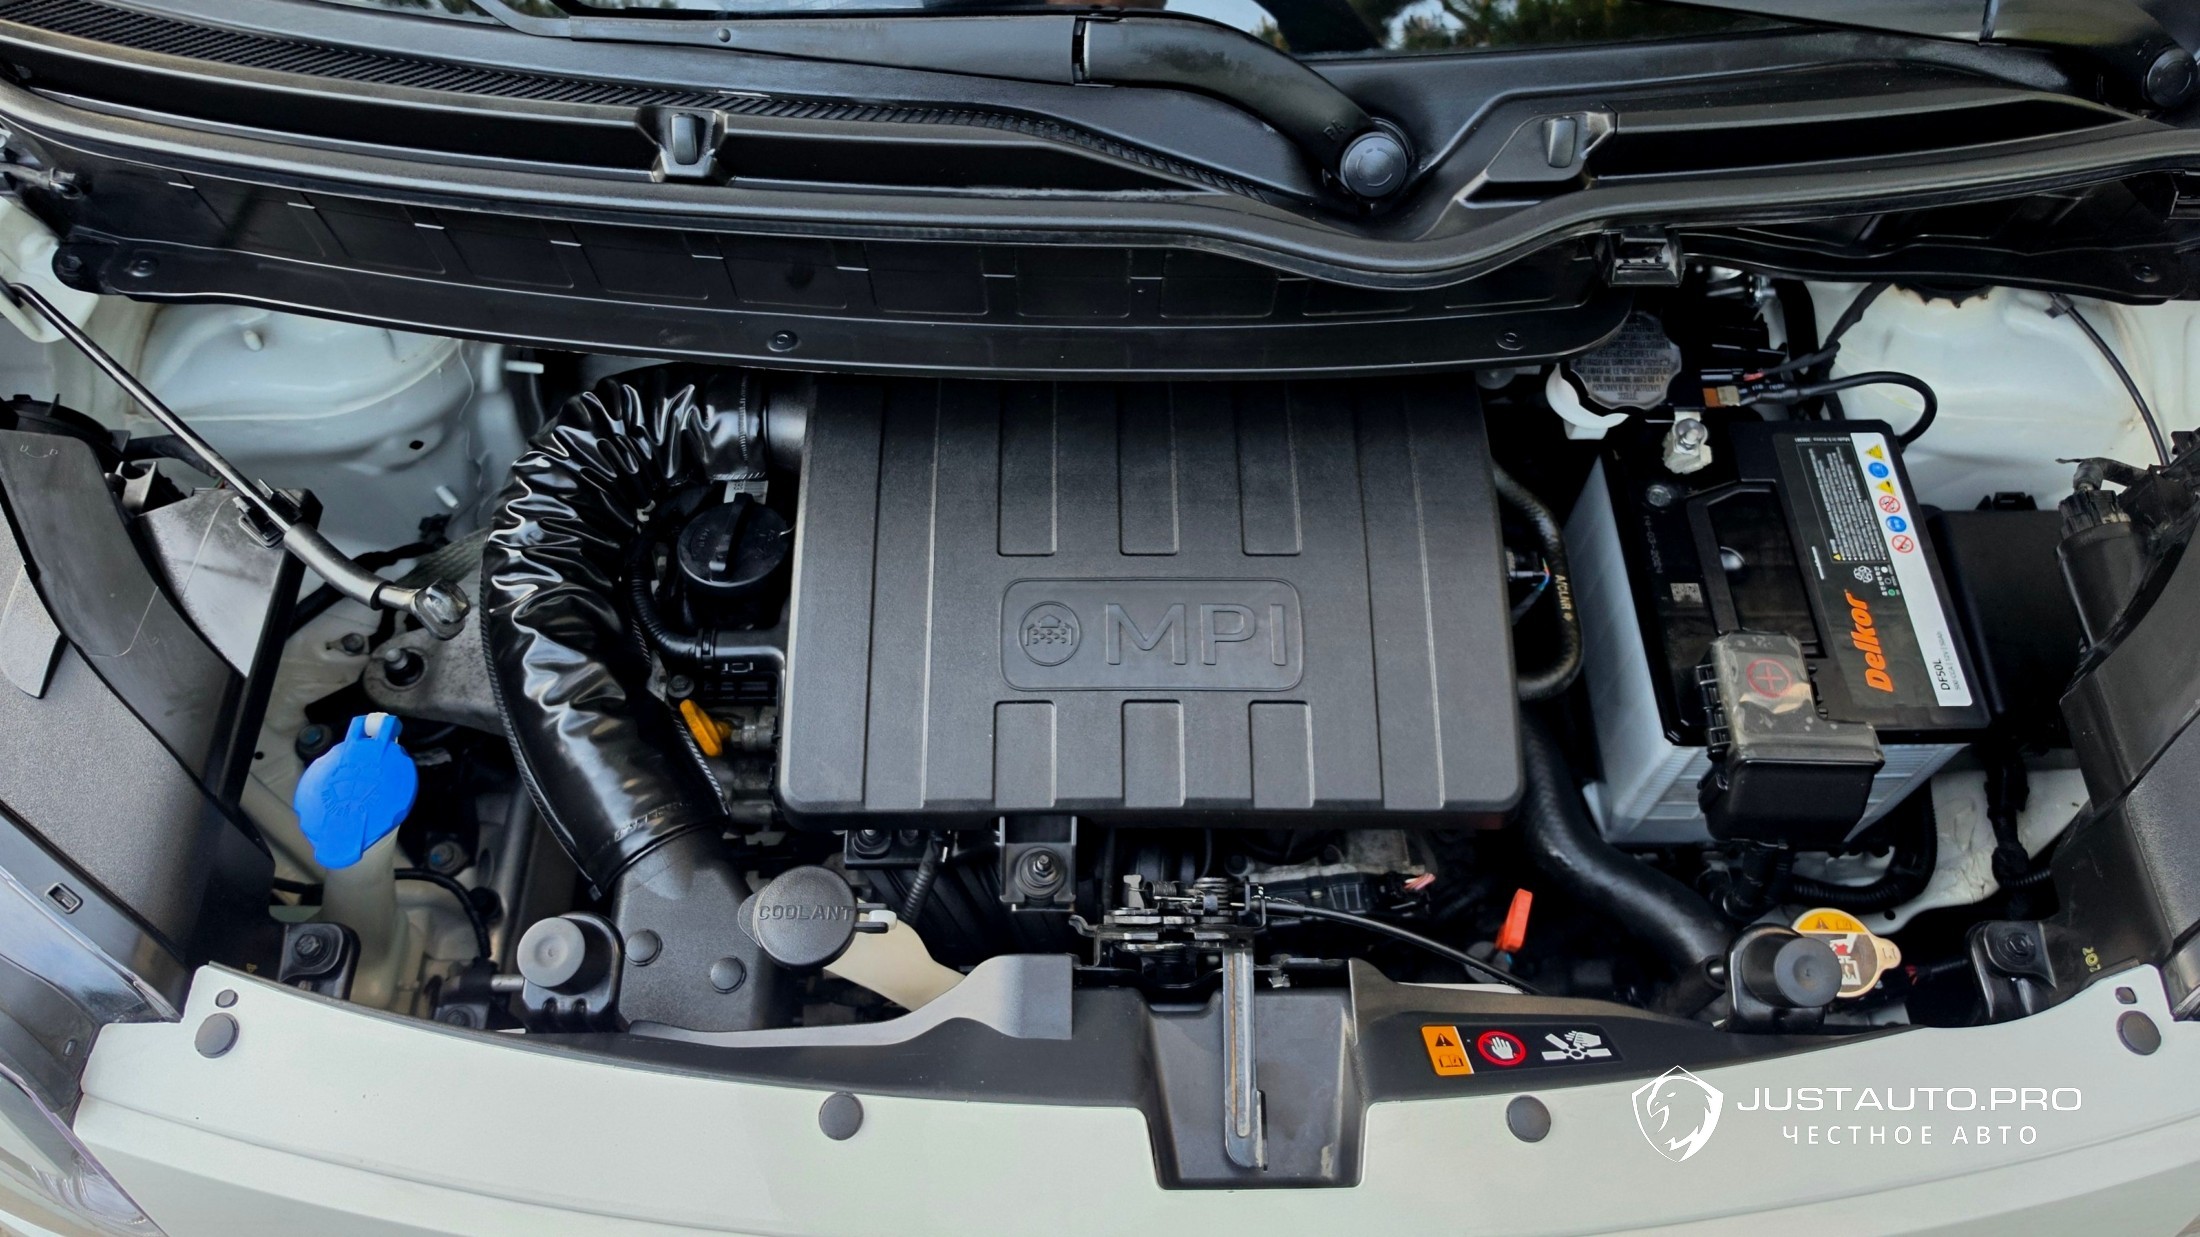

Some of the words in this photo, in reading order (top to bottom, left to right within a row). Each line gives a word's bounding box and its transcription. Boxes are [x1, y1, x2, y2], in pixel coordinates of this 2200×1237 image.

[1105, 603, 1288, 666] MPI
[1845, 592, 1894, 692] Delkor
[1932, 659, 1950, 690] DF50L
[759, 904, 854, 921] COOLANT
